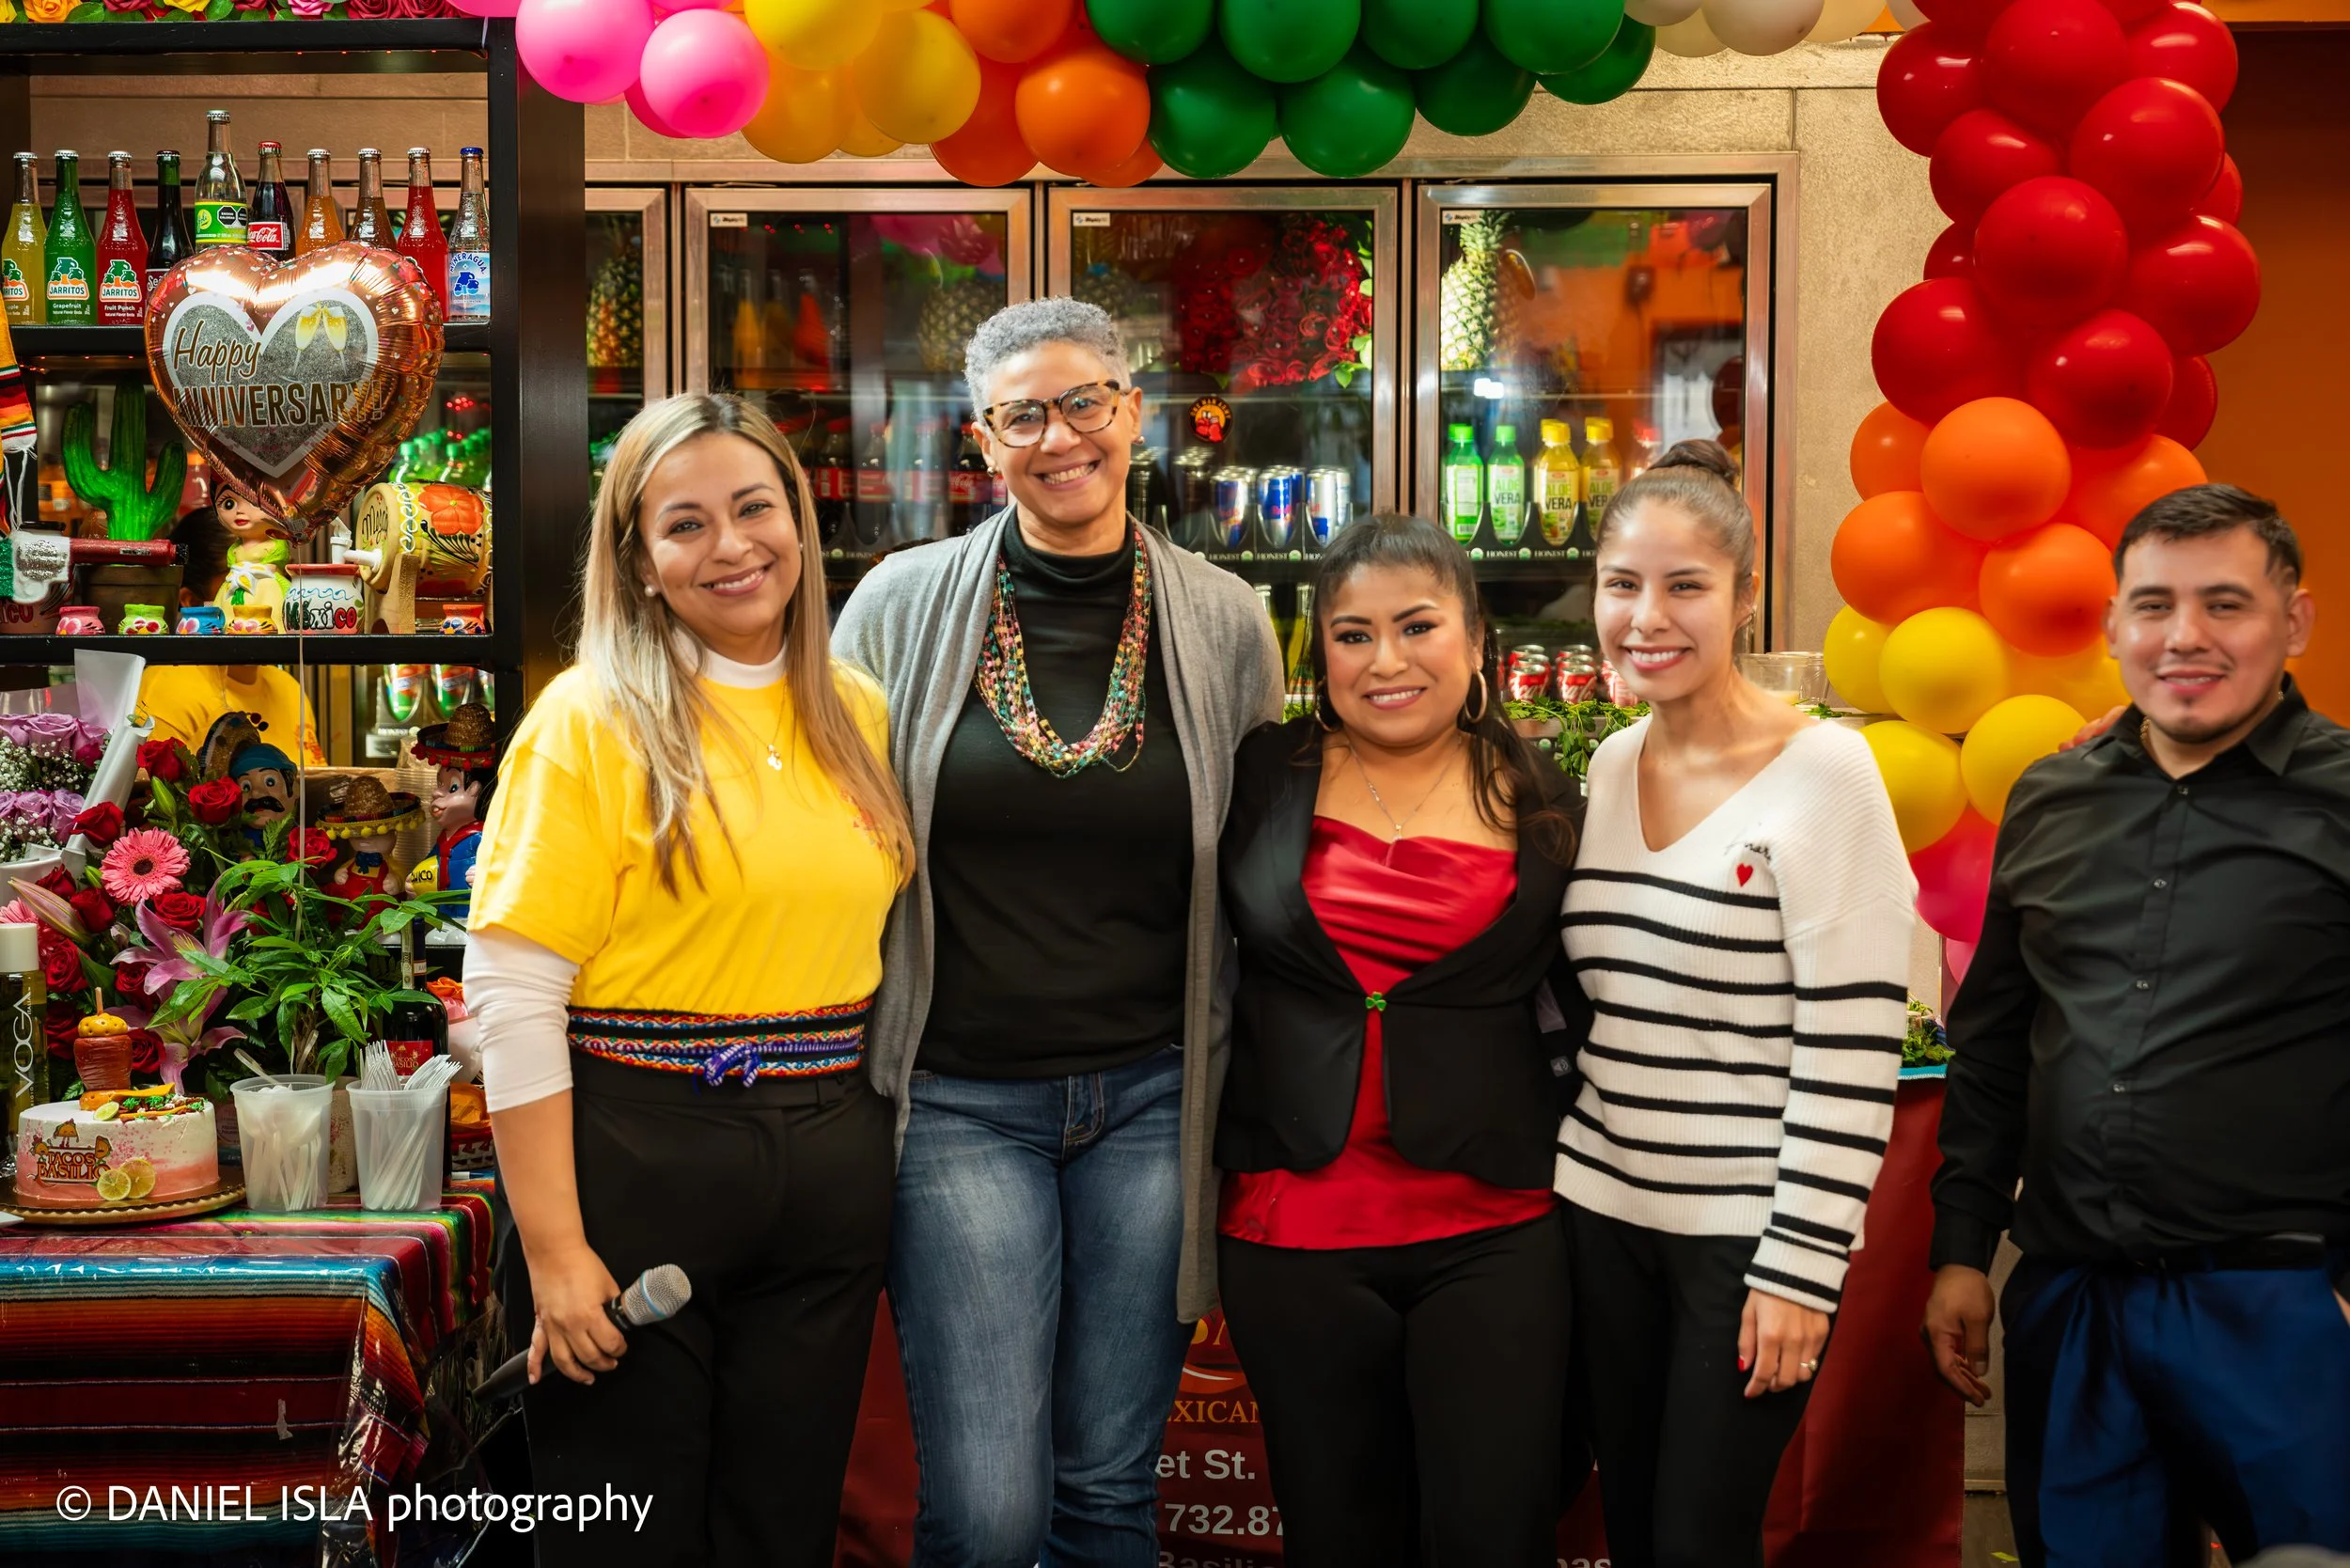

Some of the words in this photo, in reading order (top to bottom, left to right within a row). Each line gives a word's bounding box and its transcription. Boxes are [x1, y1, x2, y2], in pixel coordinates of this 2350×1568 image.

[450, 252, 487, 273] MINERAGUA
[102, 289, 137, 297] JARRITOS
[173, 320, 261, 383] Happy
[1496, 478, 1520, 491] ALOE
[1546, 483, 1572, 495] ALOE
[1495, 493, 1521, 505] VERA
[1545, 497, 1572, 510] VERA
[286, 598, 357, 631] México
[13, 991, 34, 1098] VOGA
[47, 1152, 97, 1166] TACOS
[1203, 1450, 1256, 1480] St.
